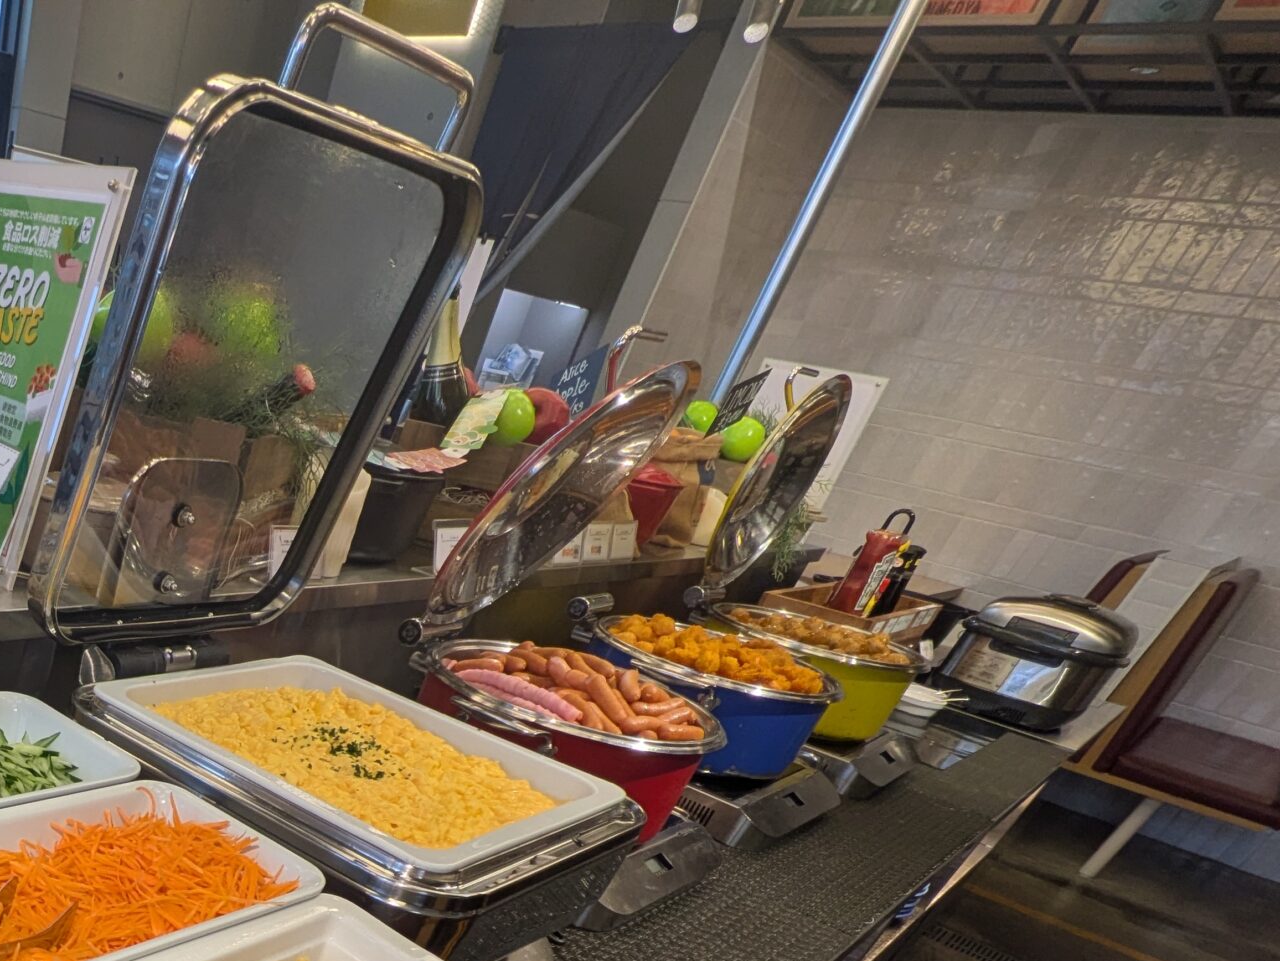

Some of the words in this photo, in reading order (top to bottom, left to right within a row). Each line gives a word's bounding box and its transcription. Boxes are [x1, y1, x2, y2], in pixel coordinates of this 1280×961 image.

[2, 219, 62, 250] 食品ロス削減
